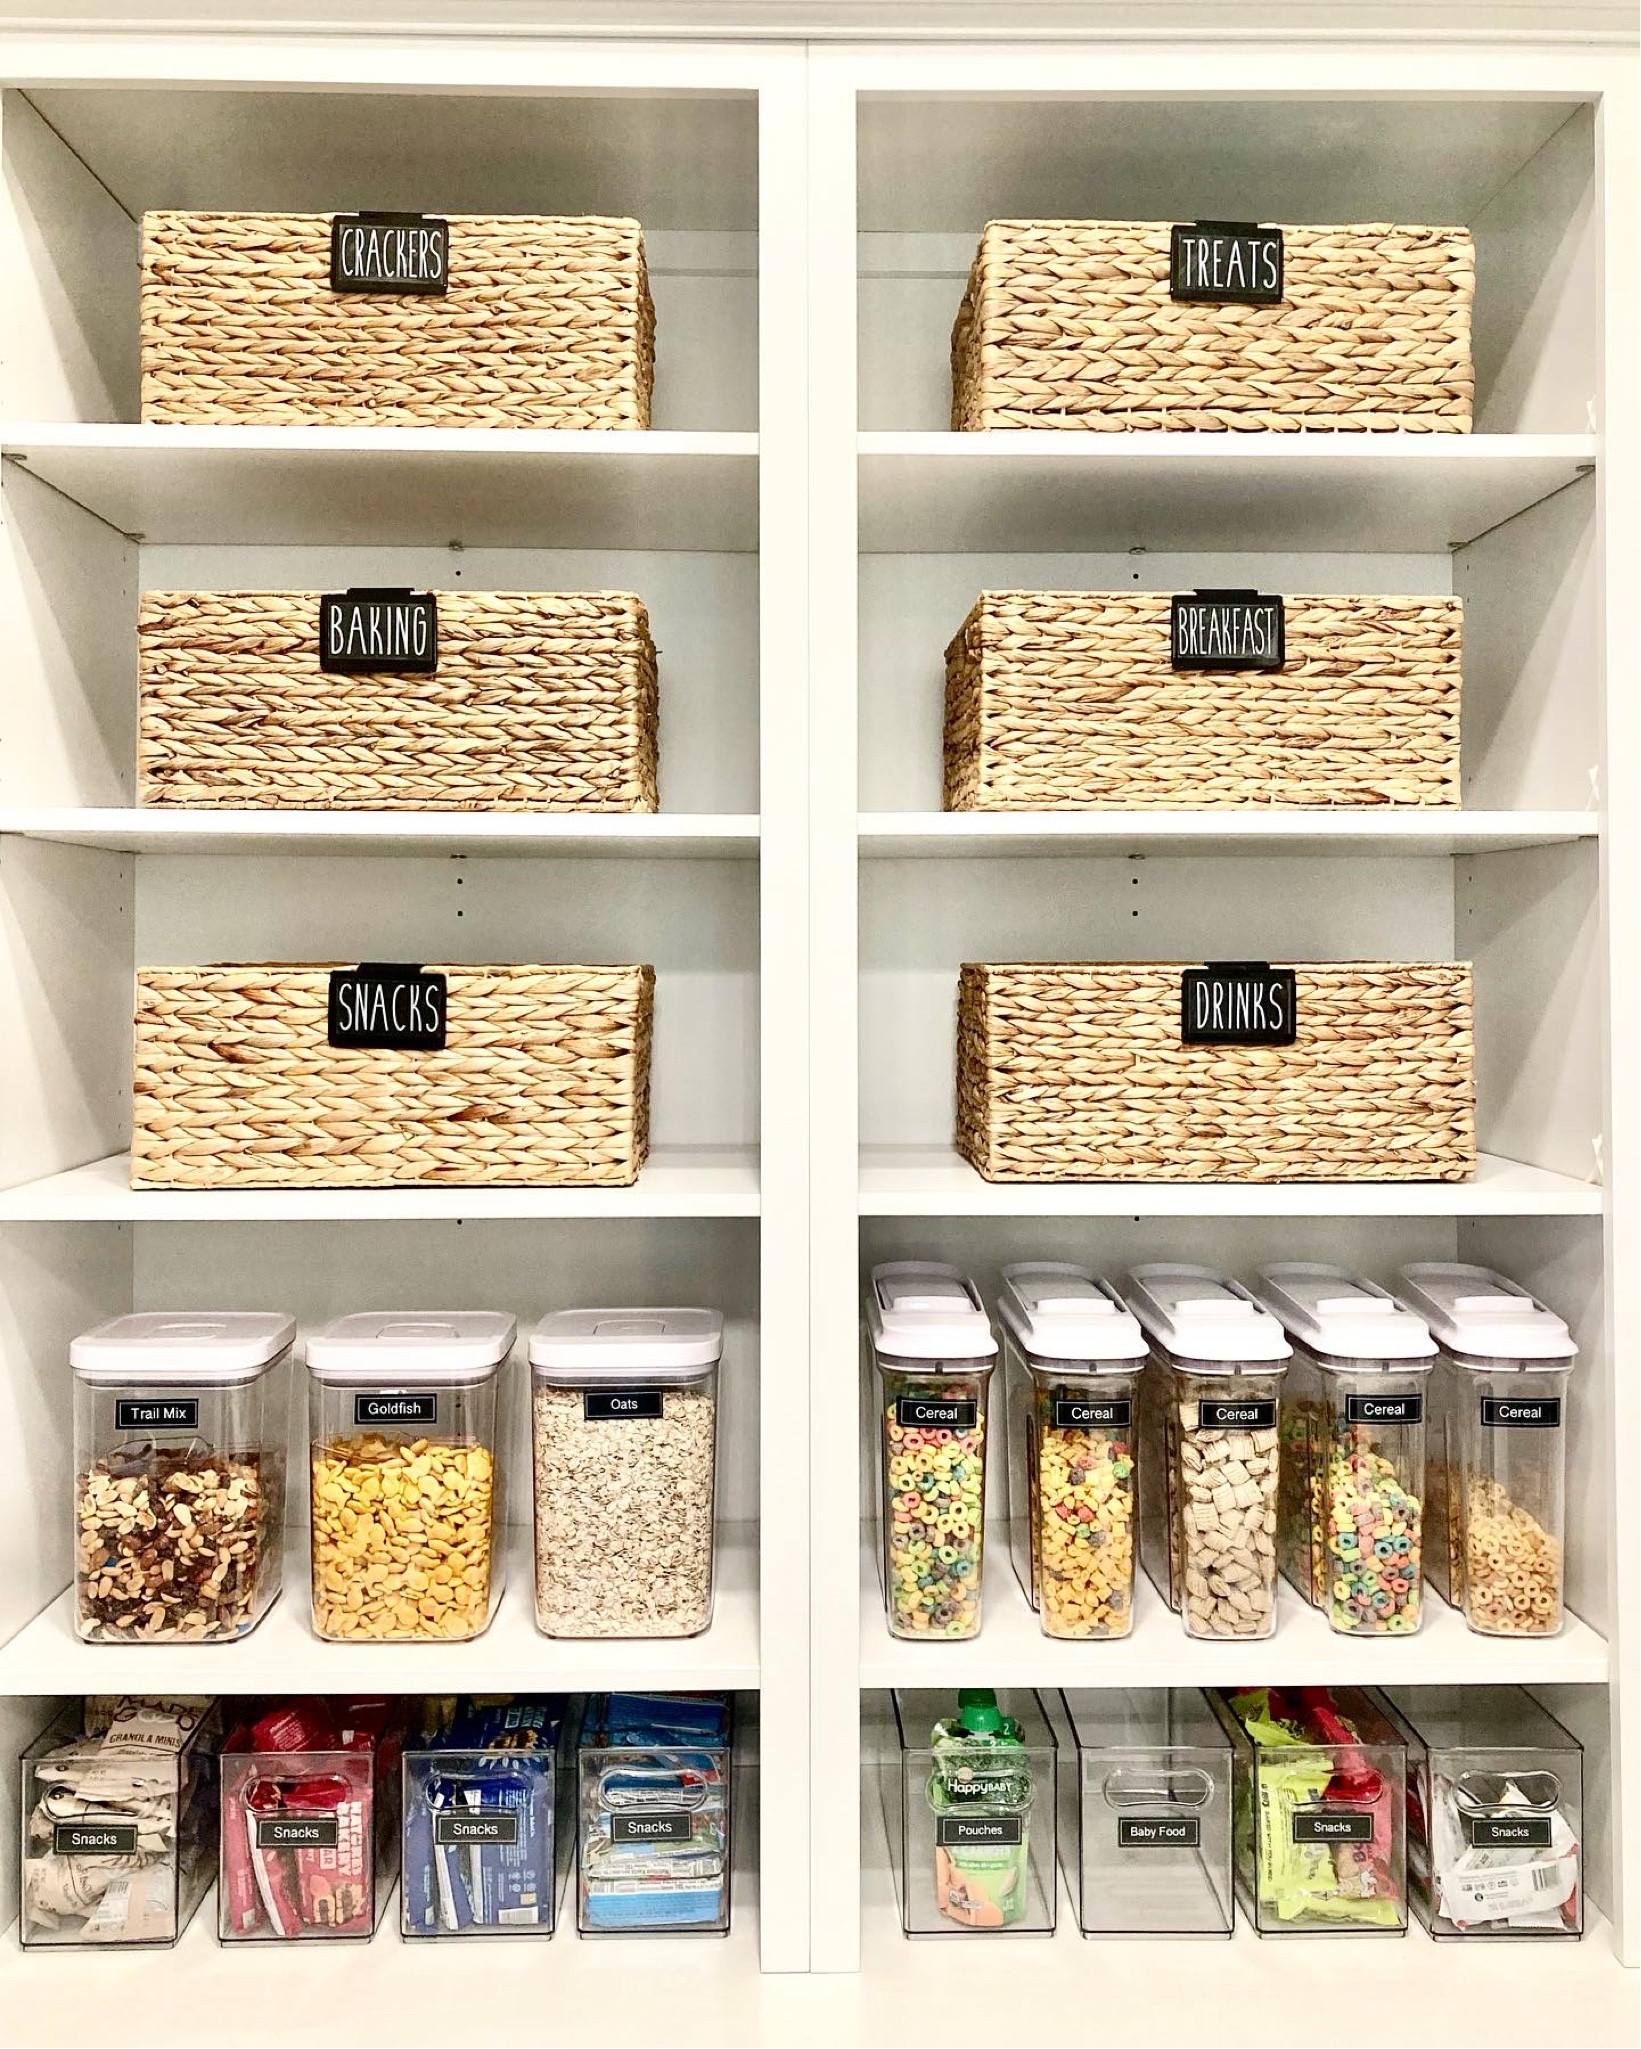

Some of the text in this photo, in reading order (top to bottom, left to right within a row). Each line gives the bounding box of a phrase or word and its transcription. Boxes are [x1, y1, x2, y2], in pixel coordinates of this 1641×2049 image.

[341, 228, 442, 279] CRACKERS
[1182, 238, 1277, 289] TREATS
[330, 604, 427, 656] BAKING
[1178, 606, 1274, 655] BREAKFAST
[339, 983, 439, 1033] SNACKS
[1196, 981, 1284, 1031] DRINKS
[367, 1401, 422, 1417] Goldfish
[609, 1397, 639, 1413] Oats
[915, 1405, 958, 1421] Cereal
[1071, 1405, 1114, 1420] Cereal
[1215, 1405, 1258, 1421] Cereal
[1364, 1401, 1406, 1417] Cereal
[1499, 1404, 1542, 1420] Cereal
[131, 1406, 188, 1421] Trail Mix
[154, 1734, 181, 1748] MINIS
[273, 1825, 320, 1839] Snacks
[453, 1823, 499, 1837] Snacks
[627, 1821, 673, 1835] Snacks
[958, 1825, 1003, 1836] Pouches
[1130, 1826, 1186, 1839] Baby Food
[1313, 1821, 1352, 1833] Snacks
[1491, 1826, 1530, 1838] Snacks
[71, 1832, 118, 1846] Snacks
